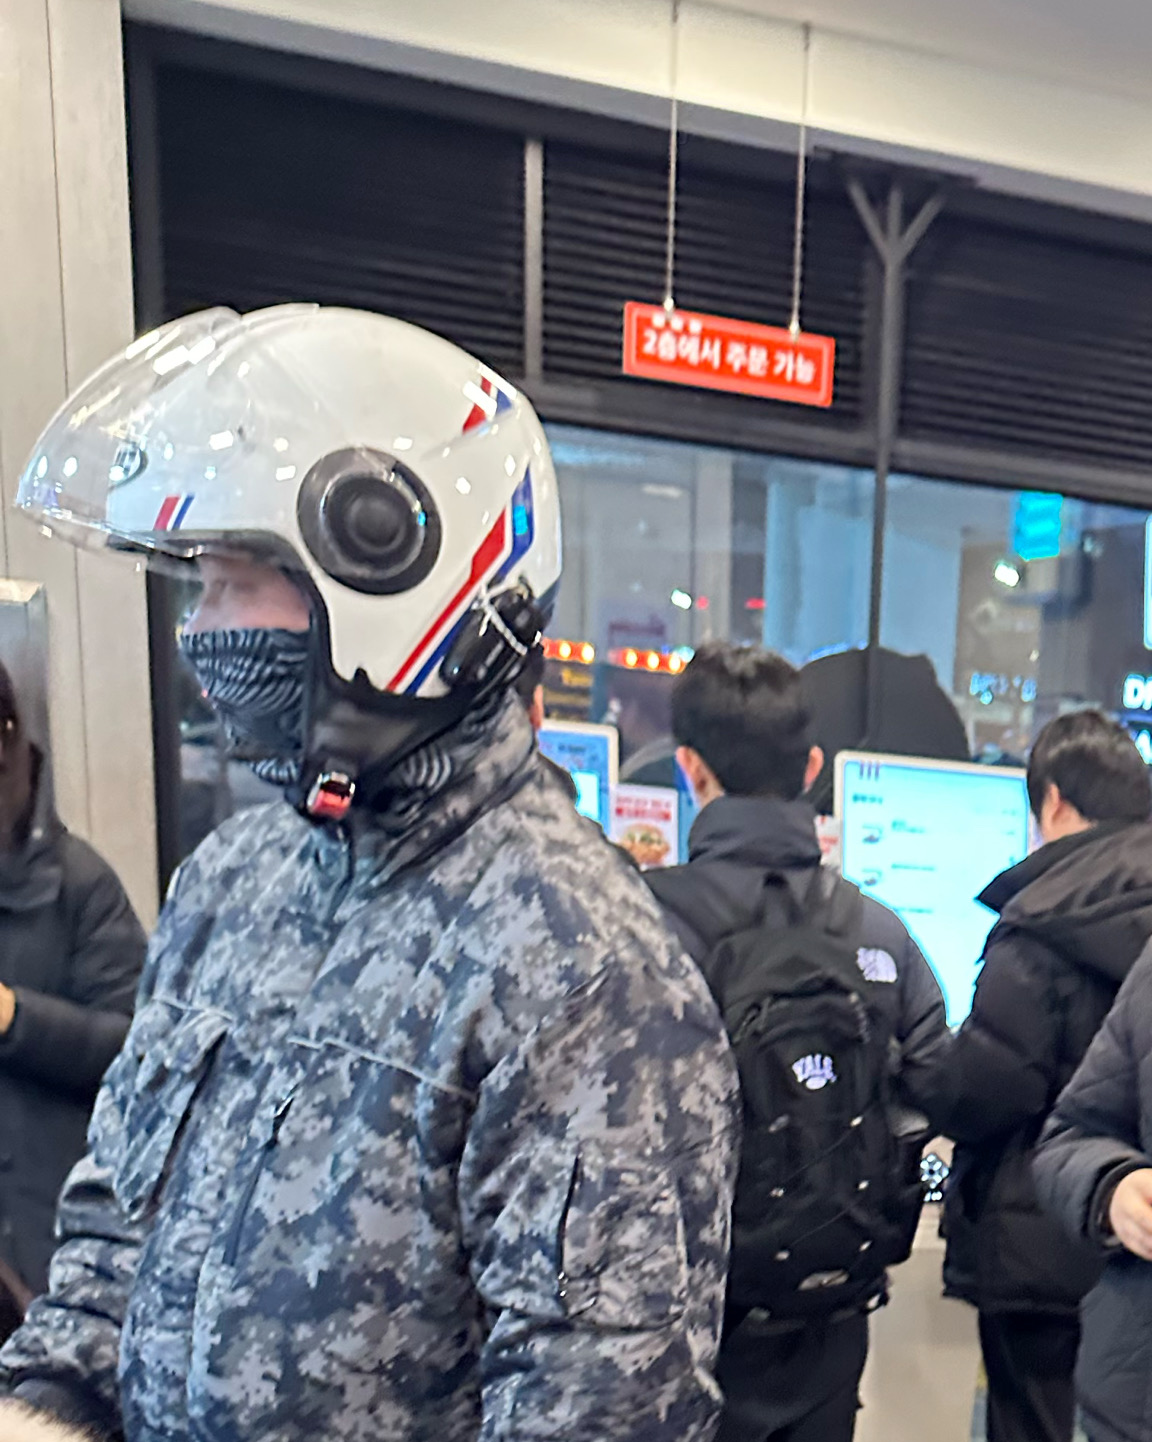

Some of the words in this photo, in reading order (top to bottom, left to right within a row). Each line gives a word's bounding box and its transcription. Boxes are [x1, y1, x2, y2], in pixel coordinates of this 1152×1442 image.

[643, 328, 721, 370] 2층에서
[725, 340, 769, 377] 주문
[773, 348, 816, 385] 가능
